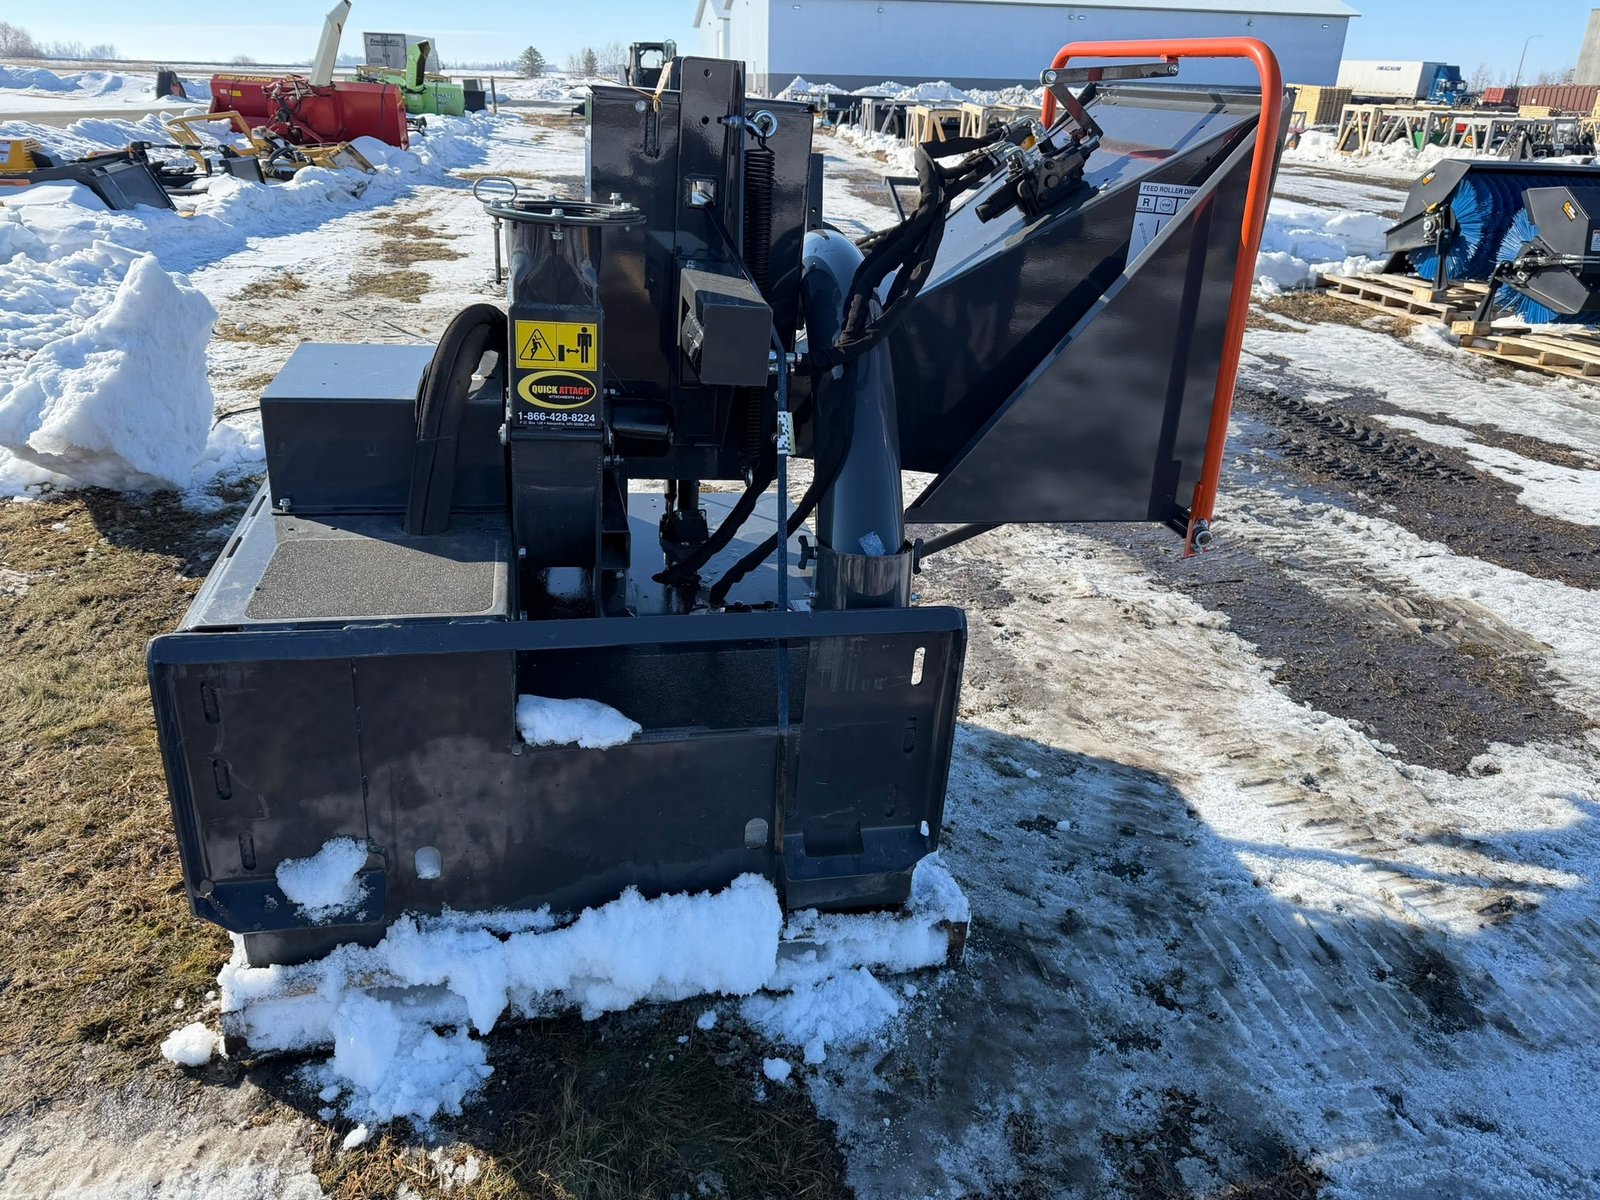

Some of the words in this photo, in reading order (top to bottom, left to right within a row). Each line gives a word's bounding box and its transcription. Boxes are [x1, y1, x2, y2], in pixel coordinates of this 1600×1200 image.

[1159, 186, 1184, 195] ROLLER
[1142, 198, 1150, 207] R
[531, 385, 558, 394] QUICK
[518, 411, 596, 422] 1-866-428-8224
